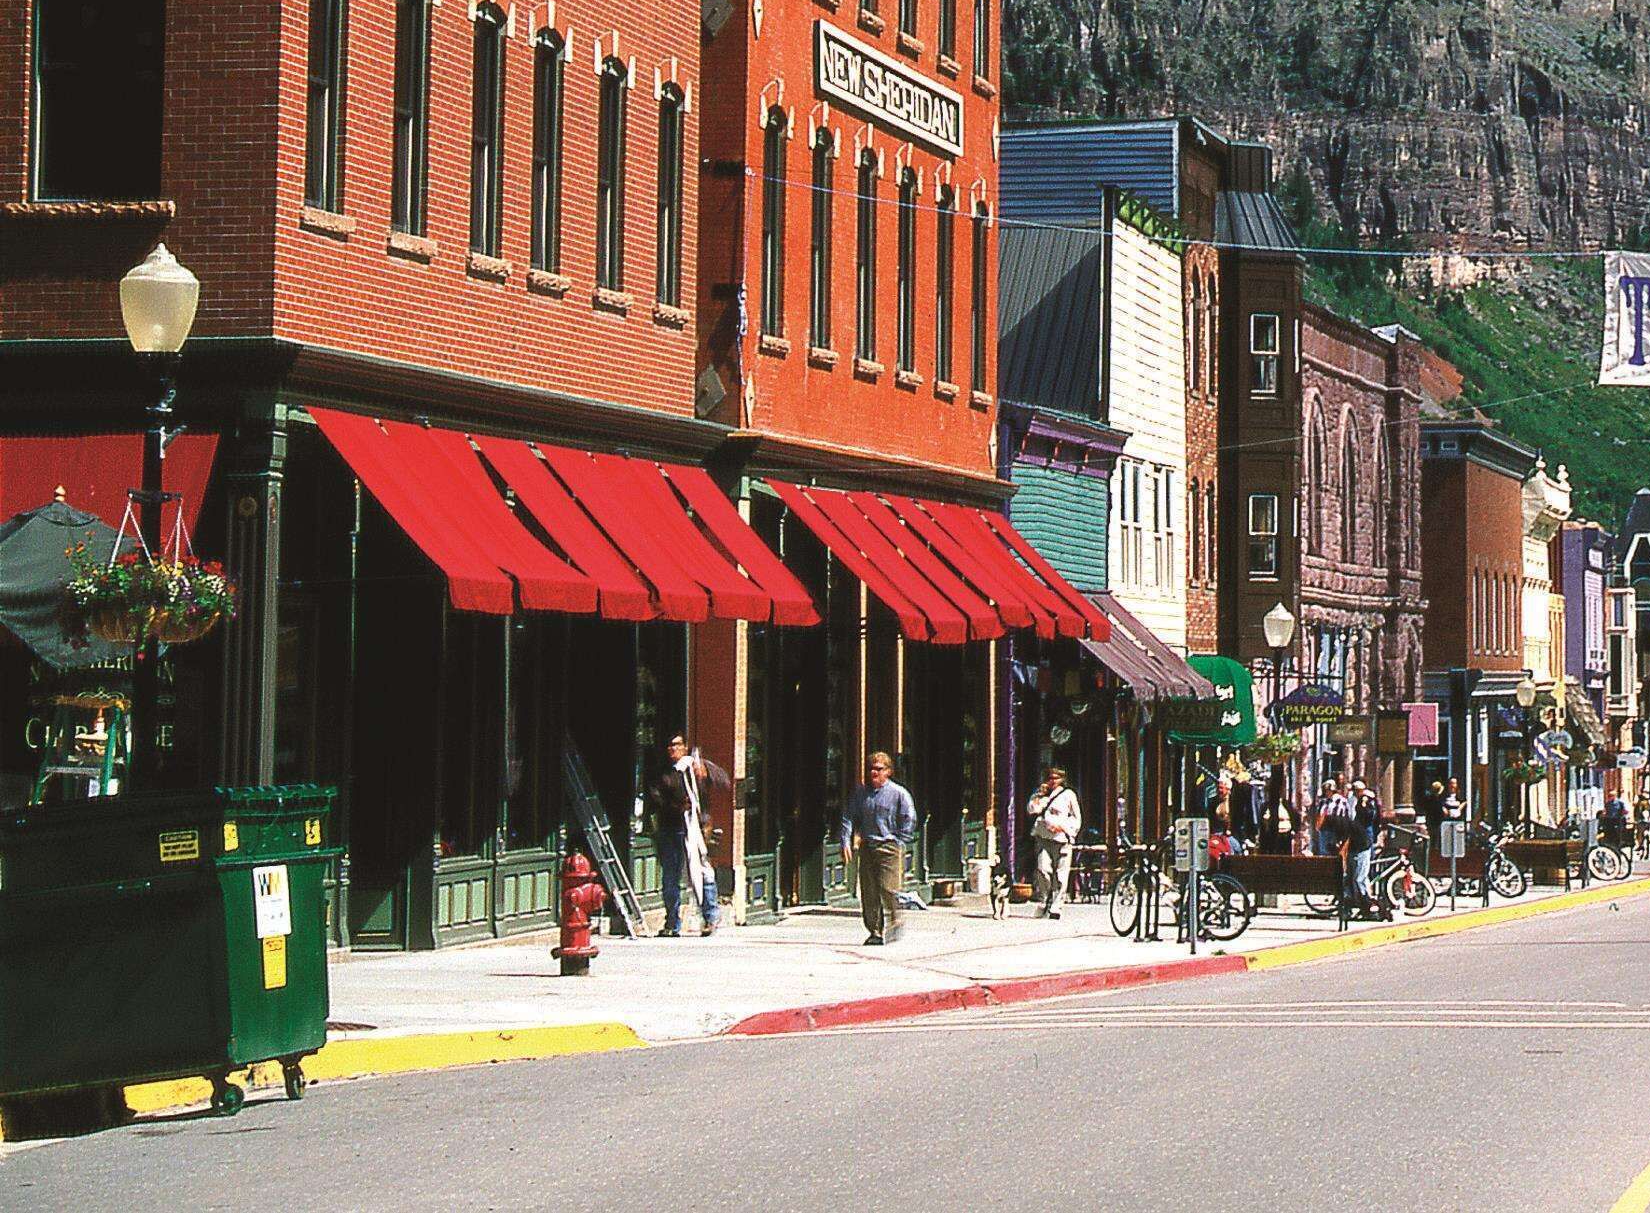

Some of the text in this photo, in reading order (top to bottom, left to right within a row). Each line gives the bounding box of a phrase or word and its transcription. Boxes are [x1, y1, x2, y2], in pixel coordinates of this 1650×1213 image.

[823, 40, 957, 144] NEW SHERIDAN
[1285, 704, 1342, 716] PARAGON
